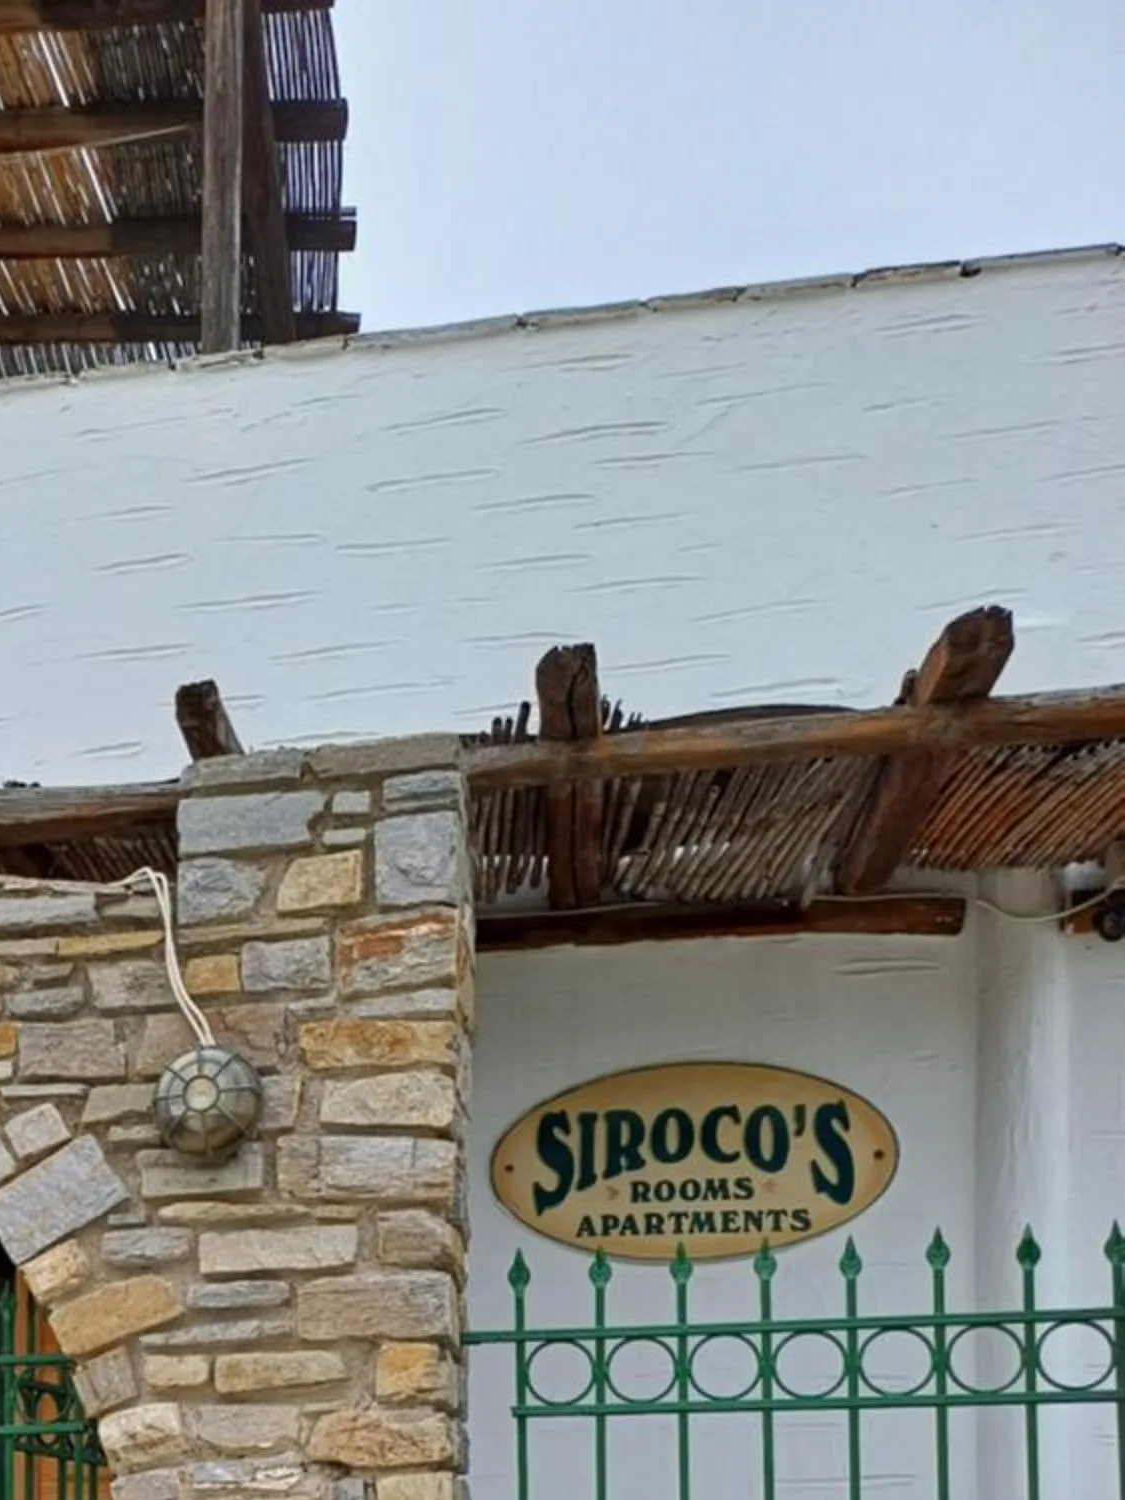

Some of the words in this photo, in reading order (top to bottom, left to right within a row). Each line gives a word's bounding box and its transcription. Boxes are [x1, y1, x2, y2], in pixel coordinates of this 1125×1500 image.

[533, 1098, 855, 1216] SIROCO'S
[630, 1177, 755, 1203] ROOMS
[575, 1208, 812, 1238] APARTMENTS
